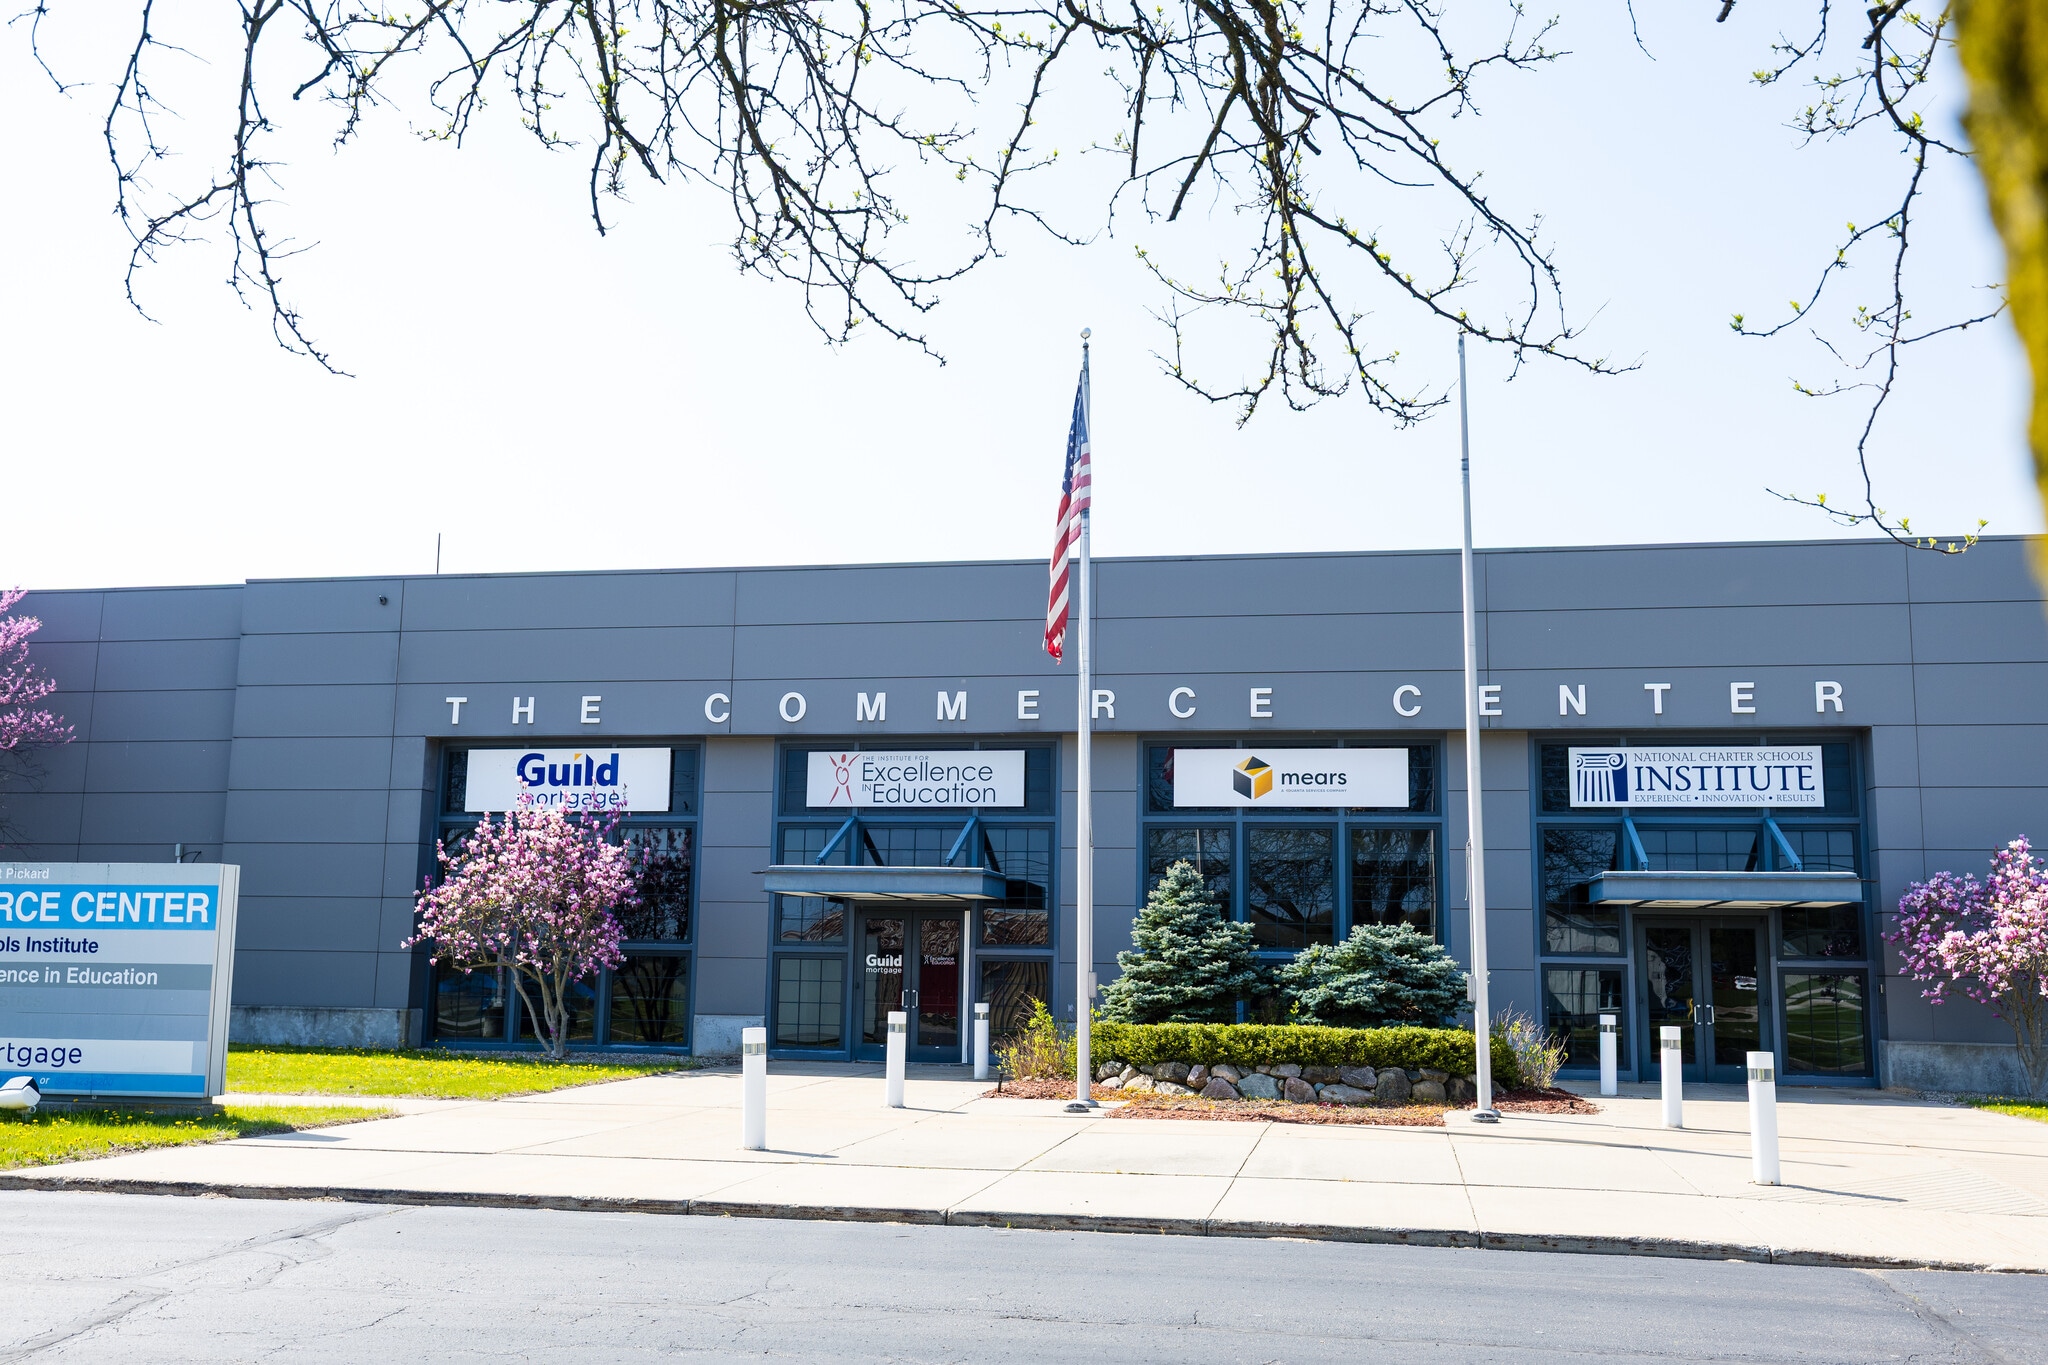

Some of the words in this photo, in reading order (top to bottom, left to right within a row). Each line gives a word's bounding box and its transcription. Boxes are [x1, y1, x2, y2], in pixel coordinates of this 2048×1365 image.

[446, 695, 602, 725] THE
[704, 687, 1273, 724] COMMERCE
[1392, 681, 1844, 717] CENTER
[1634, 752, 1697, 762] NATIONAL
[1699, 751, 1754, 762] CHARTER
[1756, 751, 1814, 762] SCHOOLS
[517, 753, 619, 787] Guild
[862, 761, 993, 782] Excellence
[1281, 772, 1347, 785] mears
[1634, 765, 1815, 792] INSTITUTE
[862, 784, 871, 792] IN
[872, 783, 996, 803] Education
[1634, 794, 1692, 802] EXPERIENCE
[1701, 794, 1766, 802] INNOVATION
[1776, 794, 1816, 802] RESULTS
[6, 867, 49, 879] Pickard
[71, 891, 209, 923] CENTER
[26, 936, 99, 953] Institute
[866, 954, 902, 966] Guild
[44, 966, 60, 983] in
[66, 967, 158, 985] Education
[40, 1077, 50, 1085] or
